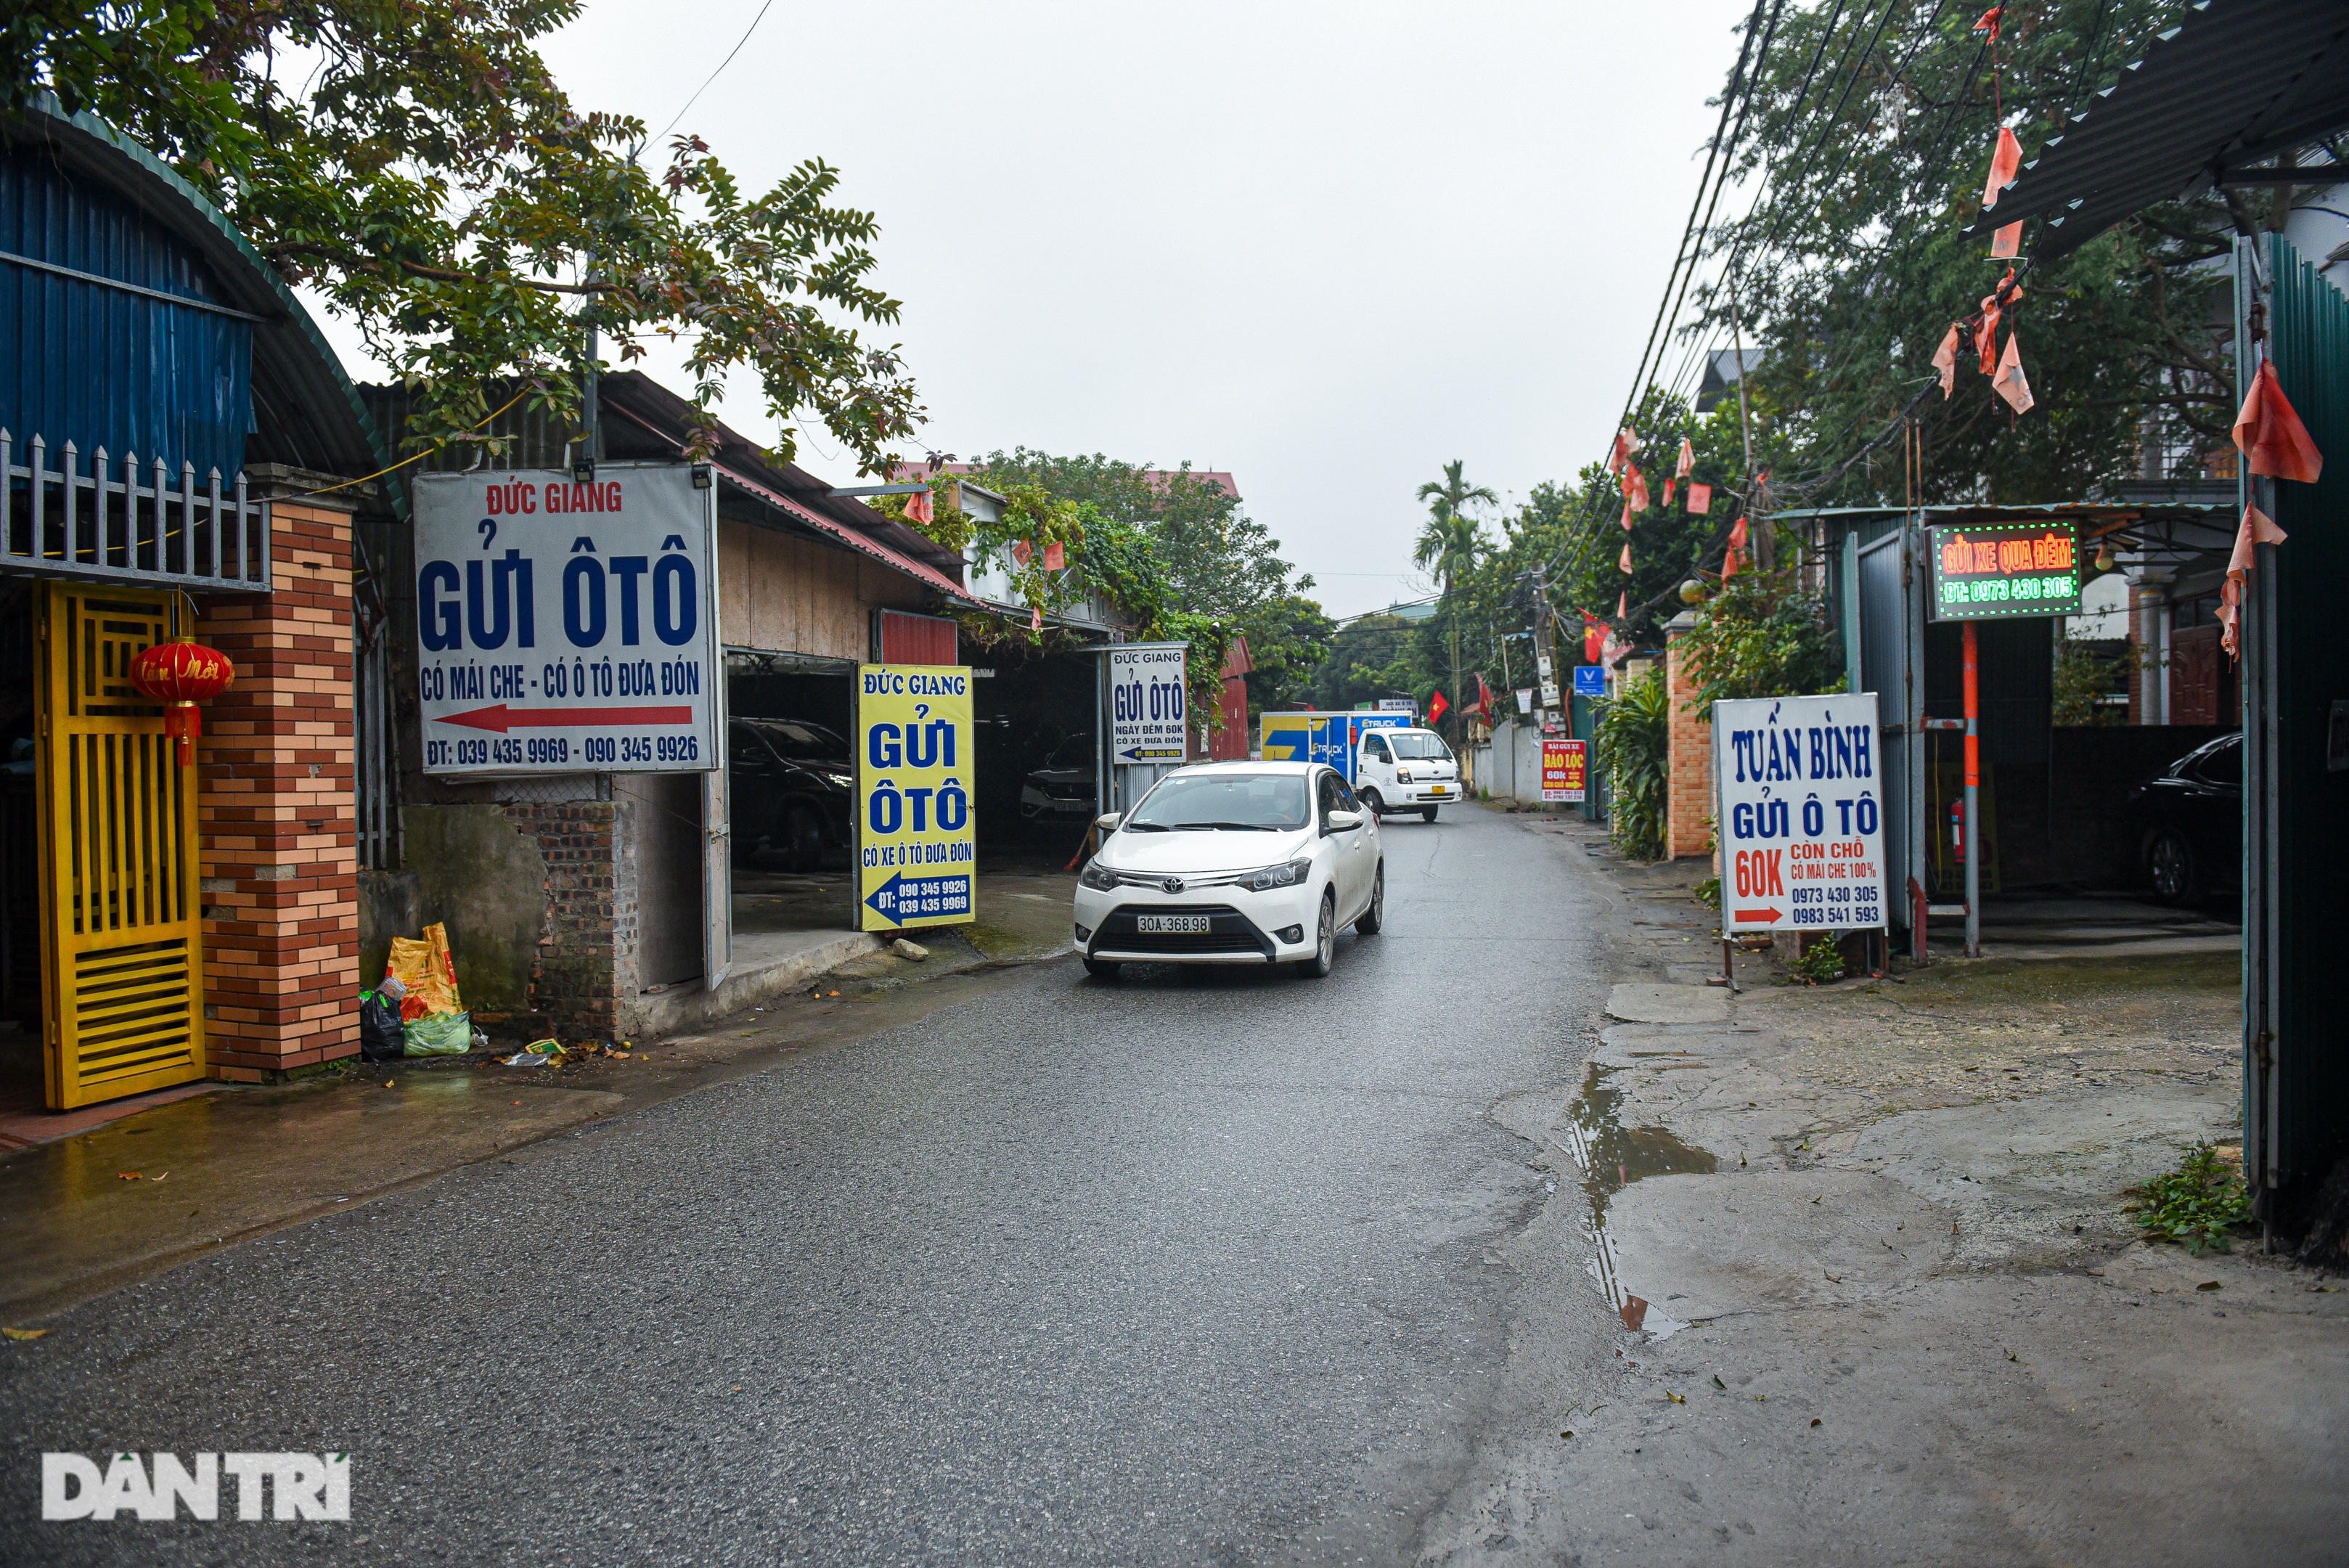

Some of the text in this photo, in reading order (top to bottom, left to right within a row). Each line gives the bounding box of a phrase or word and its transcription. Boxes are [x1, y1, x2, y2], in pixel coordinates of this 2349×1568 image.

[486, 475, 622, 515] ĐỨC GIANG
[1942, 533, 2072, 575] GỬI XE QUA ĐÊM
[418, 518, 697, 652] GỬI ÔTÔ
[1970, 579, 2010, 602] 0973
[2011, 578, 2041, 600] 430
[2042, 576, 2072, 599] 305
[1114, 652, 1181, 663] ĐỨC GIANG
[421, 659, 444, 701] CÓ
[450, 658, 484, 700] MÁI
[490, 664, 525, 699] CHE
[543, 656, 567, 698] CÓ
[573, 656, 585, 698] Ô
[590, 655, 613, 697] TÔ
[618, 658, 656, 696] ĐƯA
[661, 654, 699, 695] ĐÓN
[864, 669, 966, 696] ĐỨC GIANG
[1114, 667, 1183, 722] GỬI ÔTÔ
[868, 703, 956, 769] GỬI
[1116, 724, 1183, 735] NGÀY ĐÊM 60K
[1732, 701, 1872, 783] TUẤN BÌNH
[428, 740, 452, 765] ĐT:
[458, 739, 487, 764] 039
[493, 739, 522, 764] 435
[528, 738, 568, 763] 9969
[585, 737, 616, 762] 090
[621, 736, 651, 761] 345
[657, 735, 698, 761] 9926
[869, 777, 968, 834] ÔTÔ
[1733, 786, 1879, 839] GỬI Ô TÔ
[863, 838, 972, 867] CÓ XE Ô TÔ ĐƯA ĐÓN
[1791, 836, 1864, 859] CÒN CHỖ
[1736, 849, 1784, 897] 60K
[1791, 860, 1876, 879] CÓ MÁI CHE 100%
[878, 891, 896, 909] ĐT:
[899, 880, 967, 897] 090 345 9926
[1792, 886, 1878, 904] 0973 430 305
[899, 896, 967, 914] 039 435 9969
[1793, 906, 1879, 923] 0983 541 593
[1140, 918, 1207, 931] 30A-368.98
